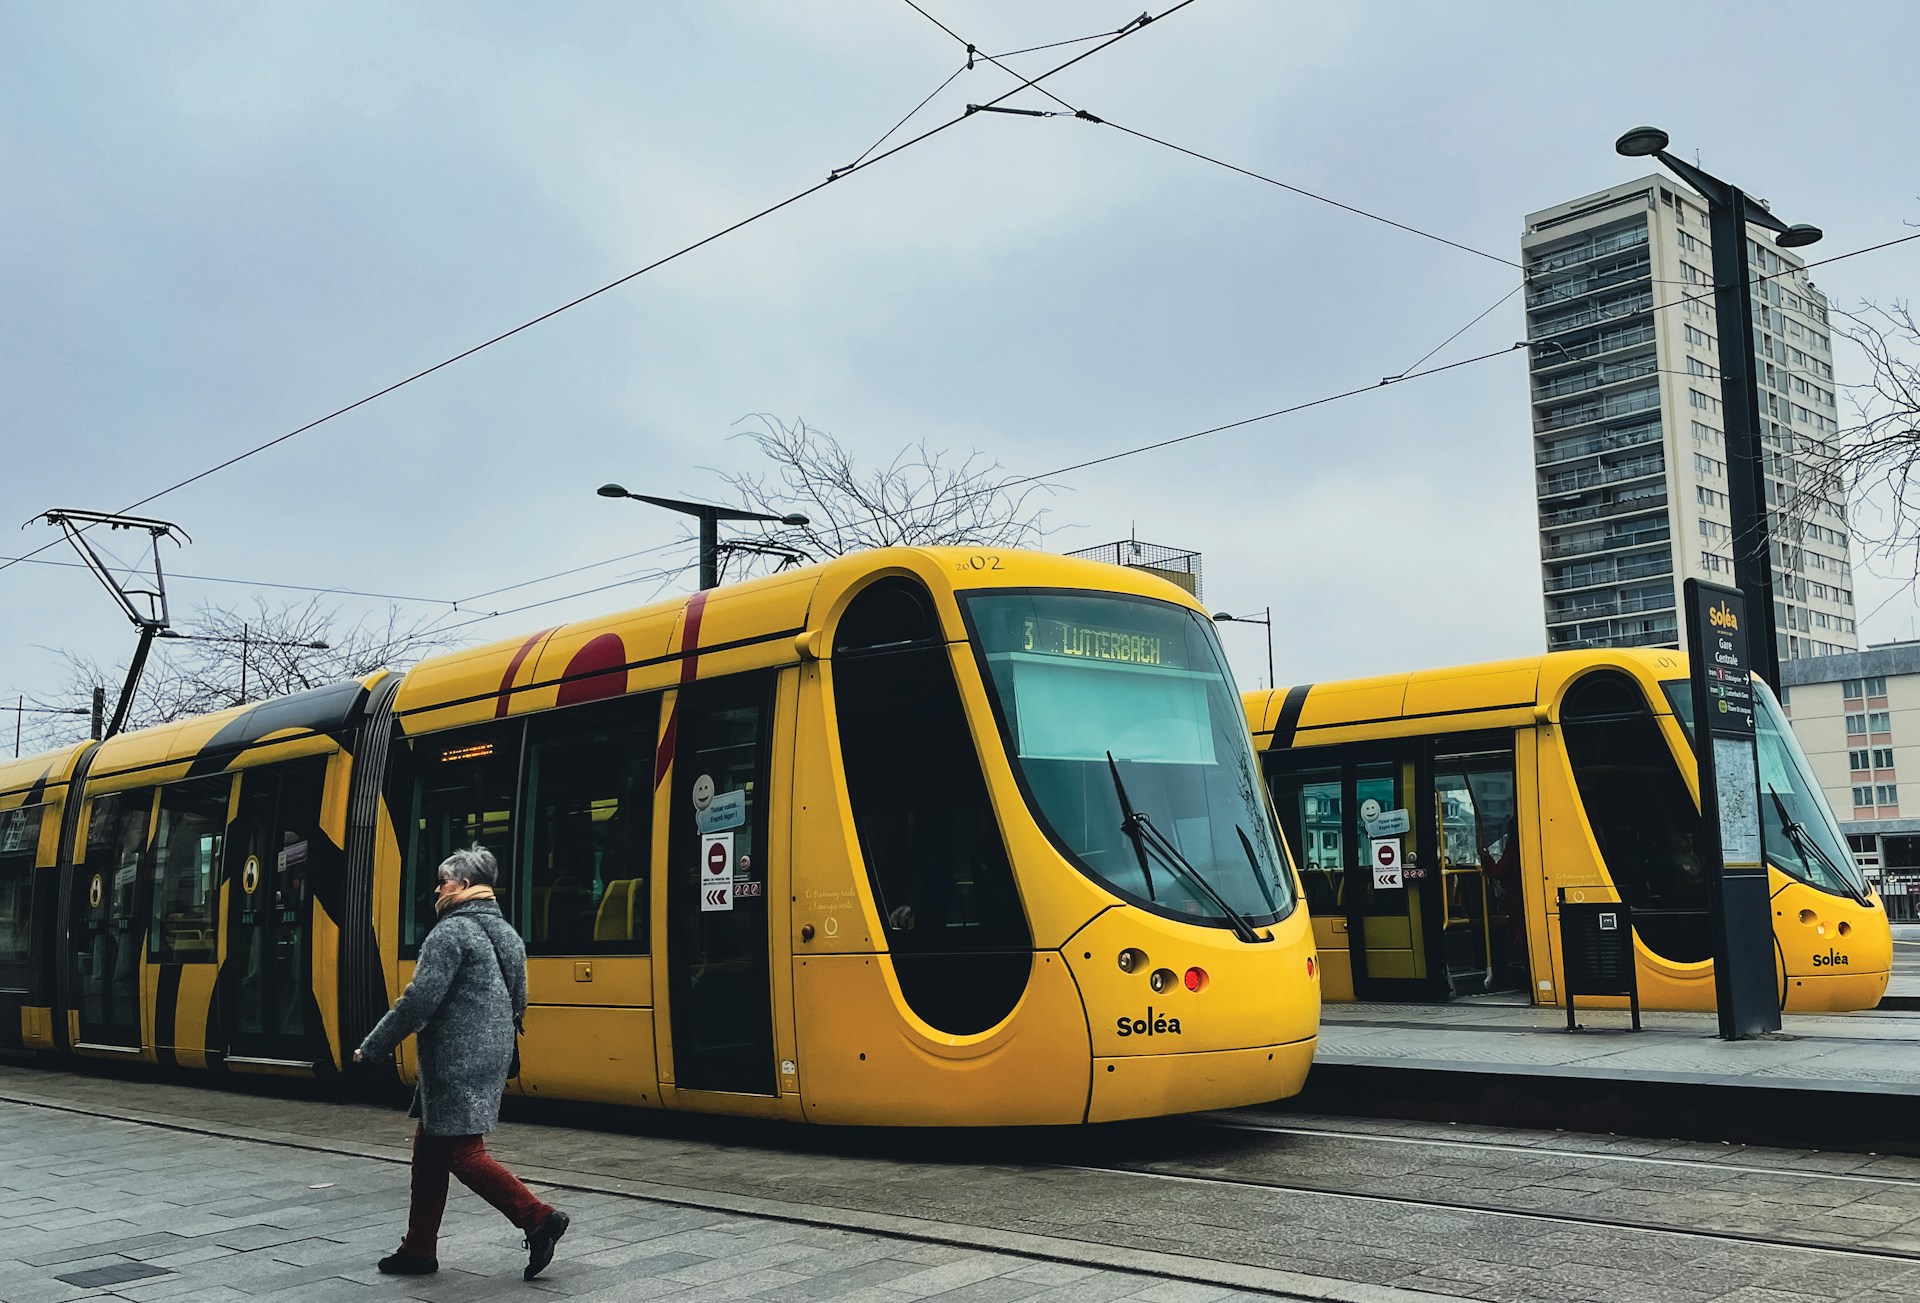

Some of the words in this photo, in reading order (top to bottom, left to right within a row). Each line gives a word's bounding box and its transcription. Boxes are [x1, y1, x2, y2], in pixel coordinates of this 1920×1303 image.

[1709, 600, 1738, 631] Soléa
[1024, 621, 1034, 650] 3
[1062, 626, 1161, 665] LUTTERBACH
[1718, 638, 1733, 651] Gare
[1715, 651, 1739, 666] Centrale
[1718, 669, 1723, 680] 1
[1720, 686, 1725, 697] 3
[1812, 947, 1849, 967] Soléa
[1116, 1006, 1182, 1037] Soléa
